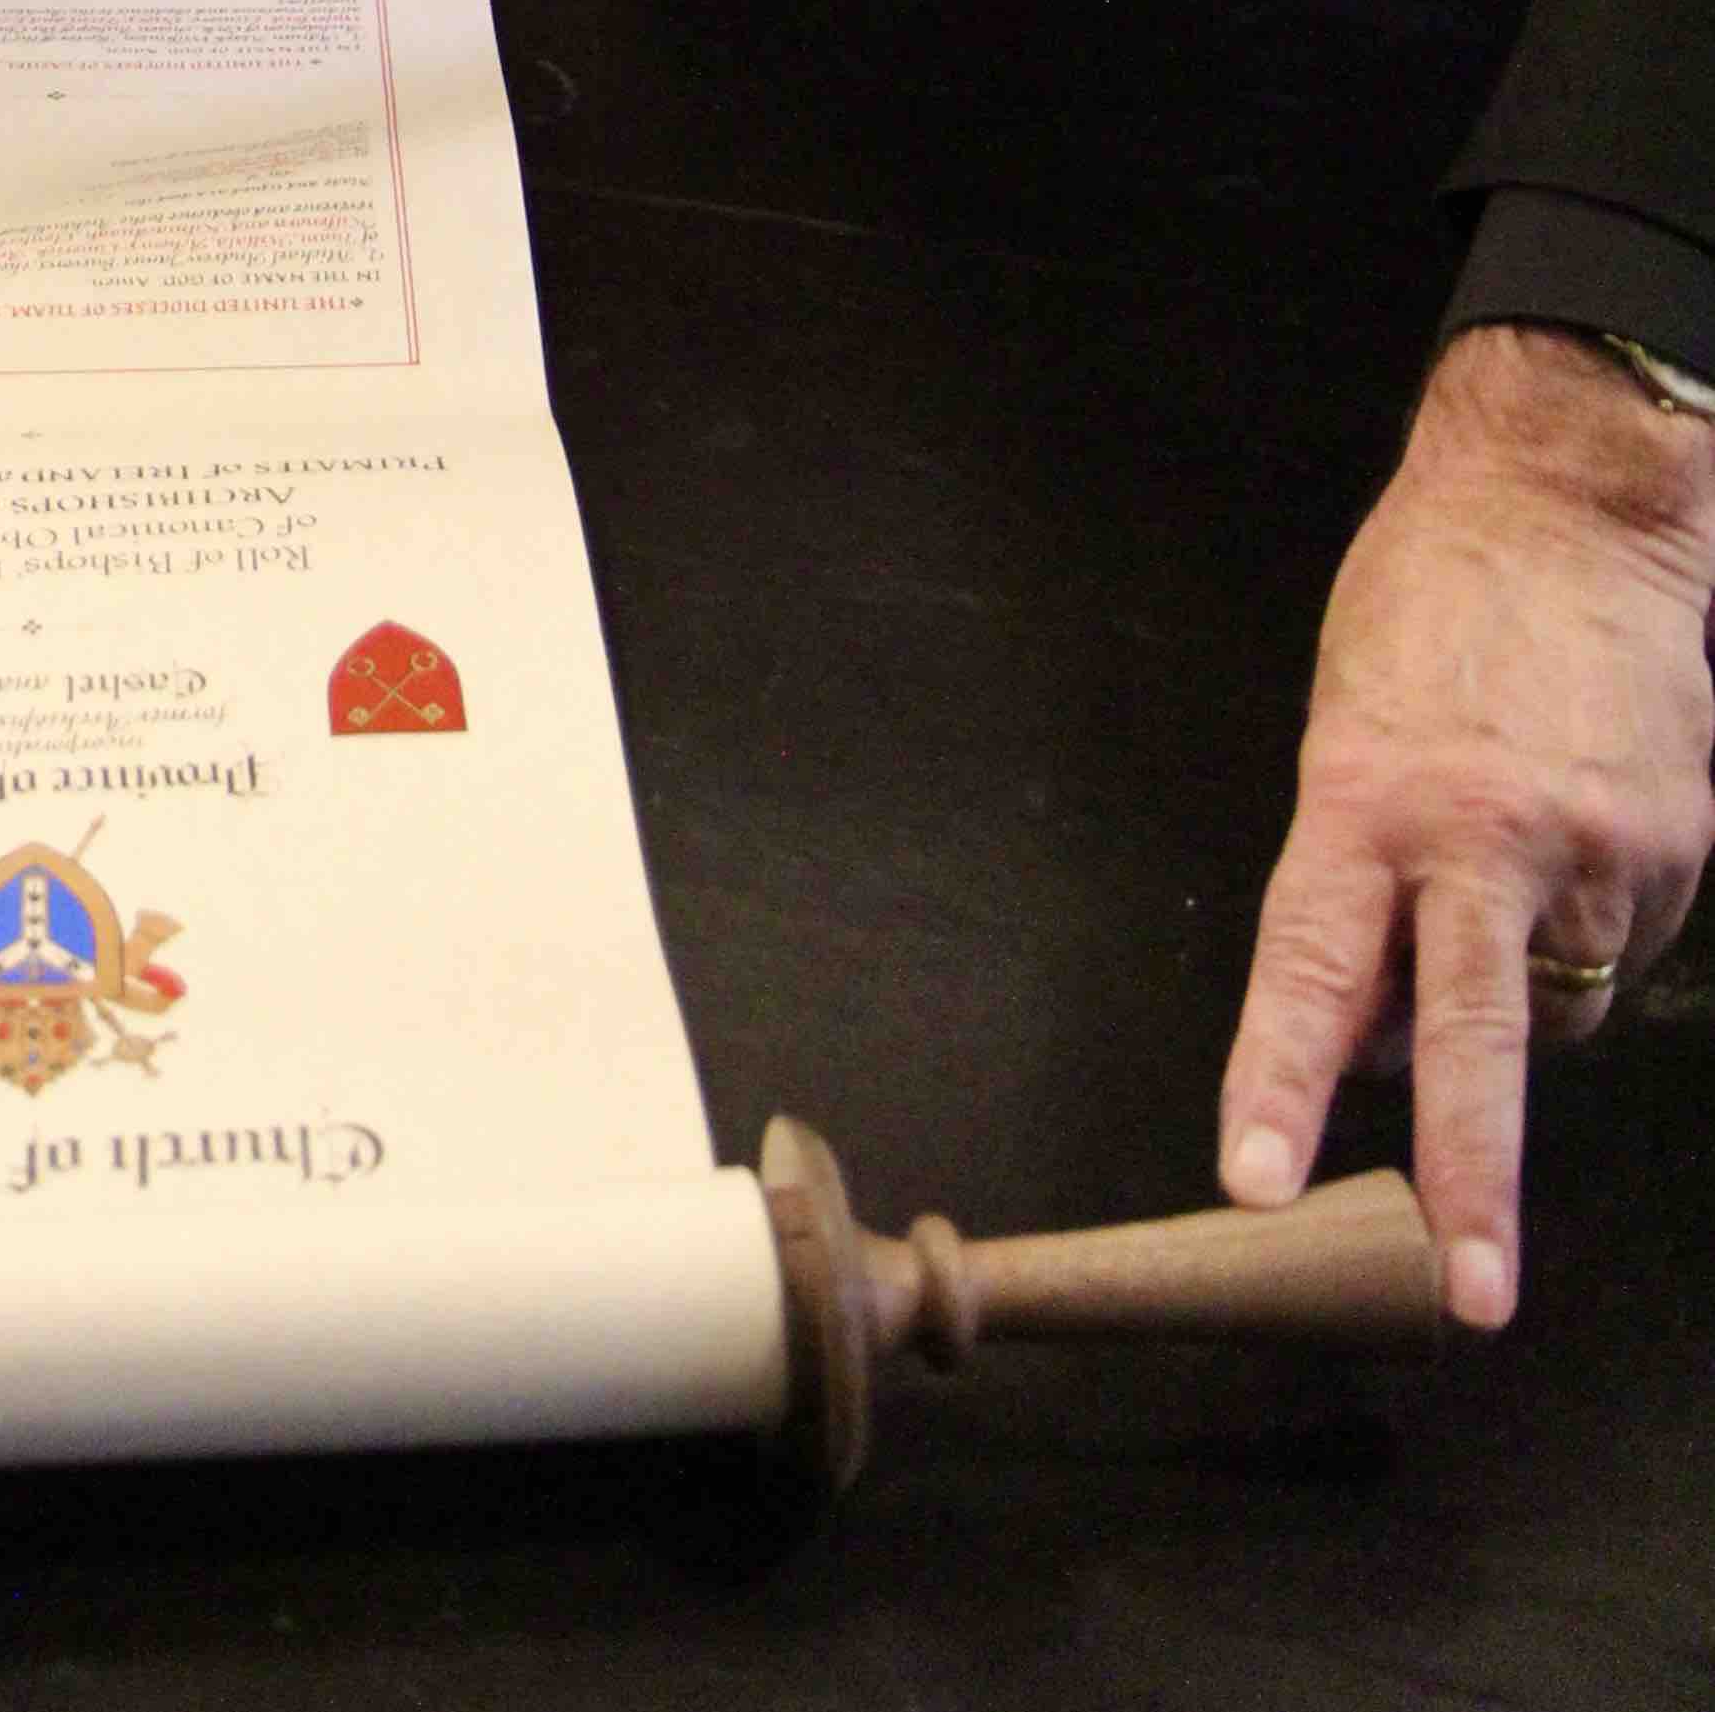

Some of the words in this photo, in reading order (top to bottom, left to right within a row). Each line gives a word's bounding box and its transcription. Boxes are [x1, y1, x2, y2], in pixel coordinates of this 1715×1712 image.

[272, 248, 353, 266] Michael
[237, 272, 305, 287] NAME
[81, 301, 104, 317] OF
[110, 299, 206, 317] DIOCESES
[212, 297, 300, 315] UNITED
[305, 296, 348, 312] THE
[21, 464, 192, 485] IRELAND
[202, 462, 242, 482] of
[253, 454, 446, 476] PRIMATES
[9, 485, 295, 515] ARCHBISHOPS
[71, 514, 266, 549] Canonical
[274, 511, 318, 538] of
[181, 548, 225, 574] of
[234, 544, 313, 573] Roll
[64, 669, 207, 702] Cashel
[139, 704, 226, 728] former
[52, 754, 267, 801] Province
[7, 1136, 82, 1194] of
[109, 1123, 385, 1187] Church
